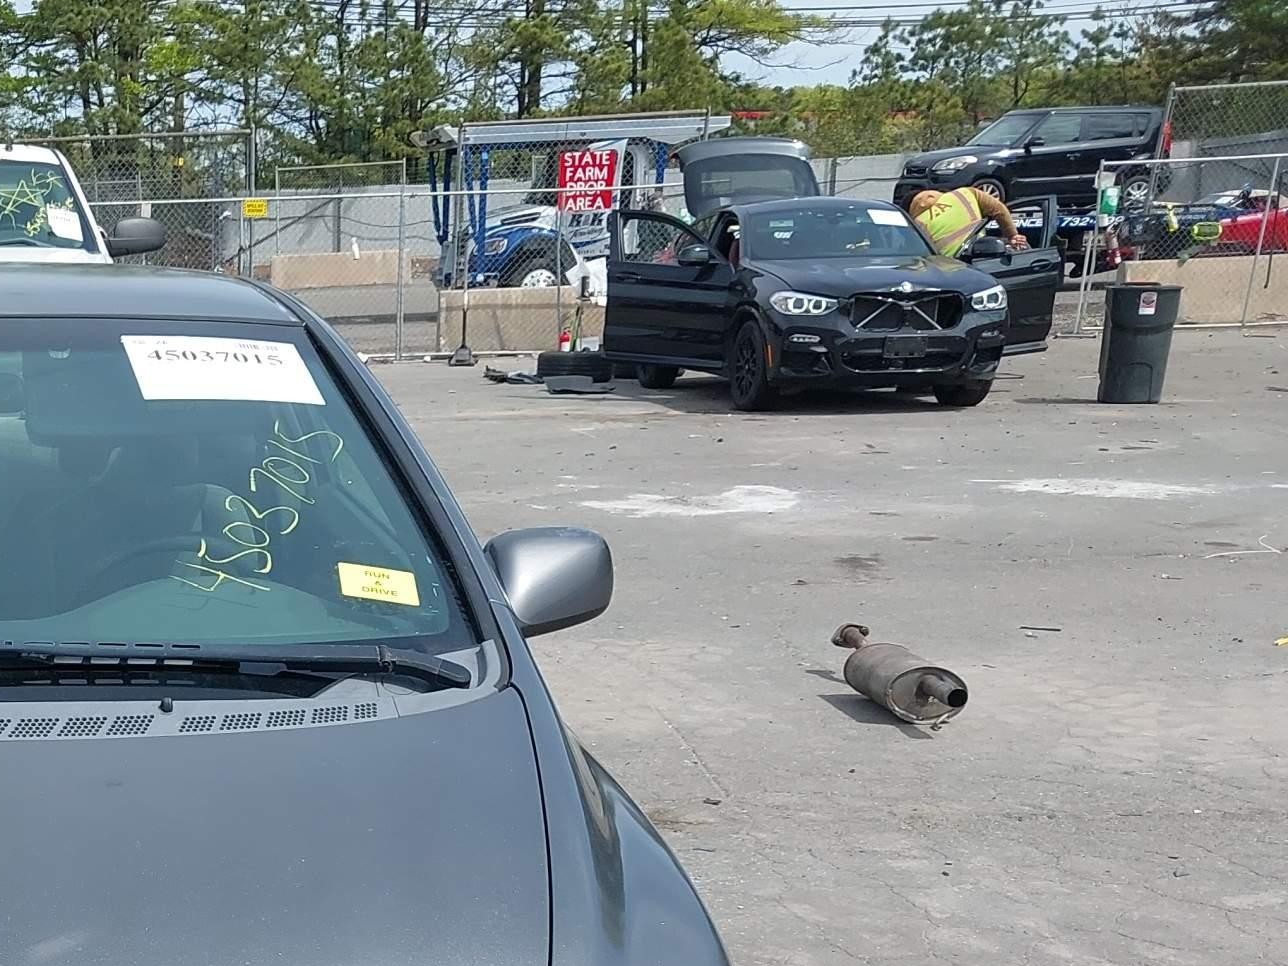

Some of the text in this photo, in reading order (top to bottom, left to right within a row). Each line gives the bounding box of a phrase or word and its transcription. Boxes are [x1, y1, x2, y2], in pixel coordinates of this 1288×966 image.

[564, 151, 610, 167] STATE
[565, 166, 608, 181] FARM
[566, 181, 607, 196] DROP
[565, 196, 604, 211] AREA
[146, 348, 284, 367] 45037015
[168, 418, 345, 592] 45037015
[364, 570, 391, 580] RUN
[361, 585, 399, 597] DRIVE
